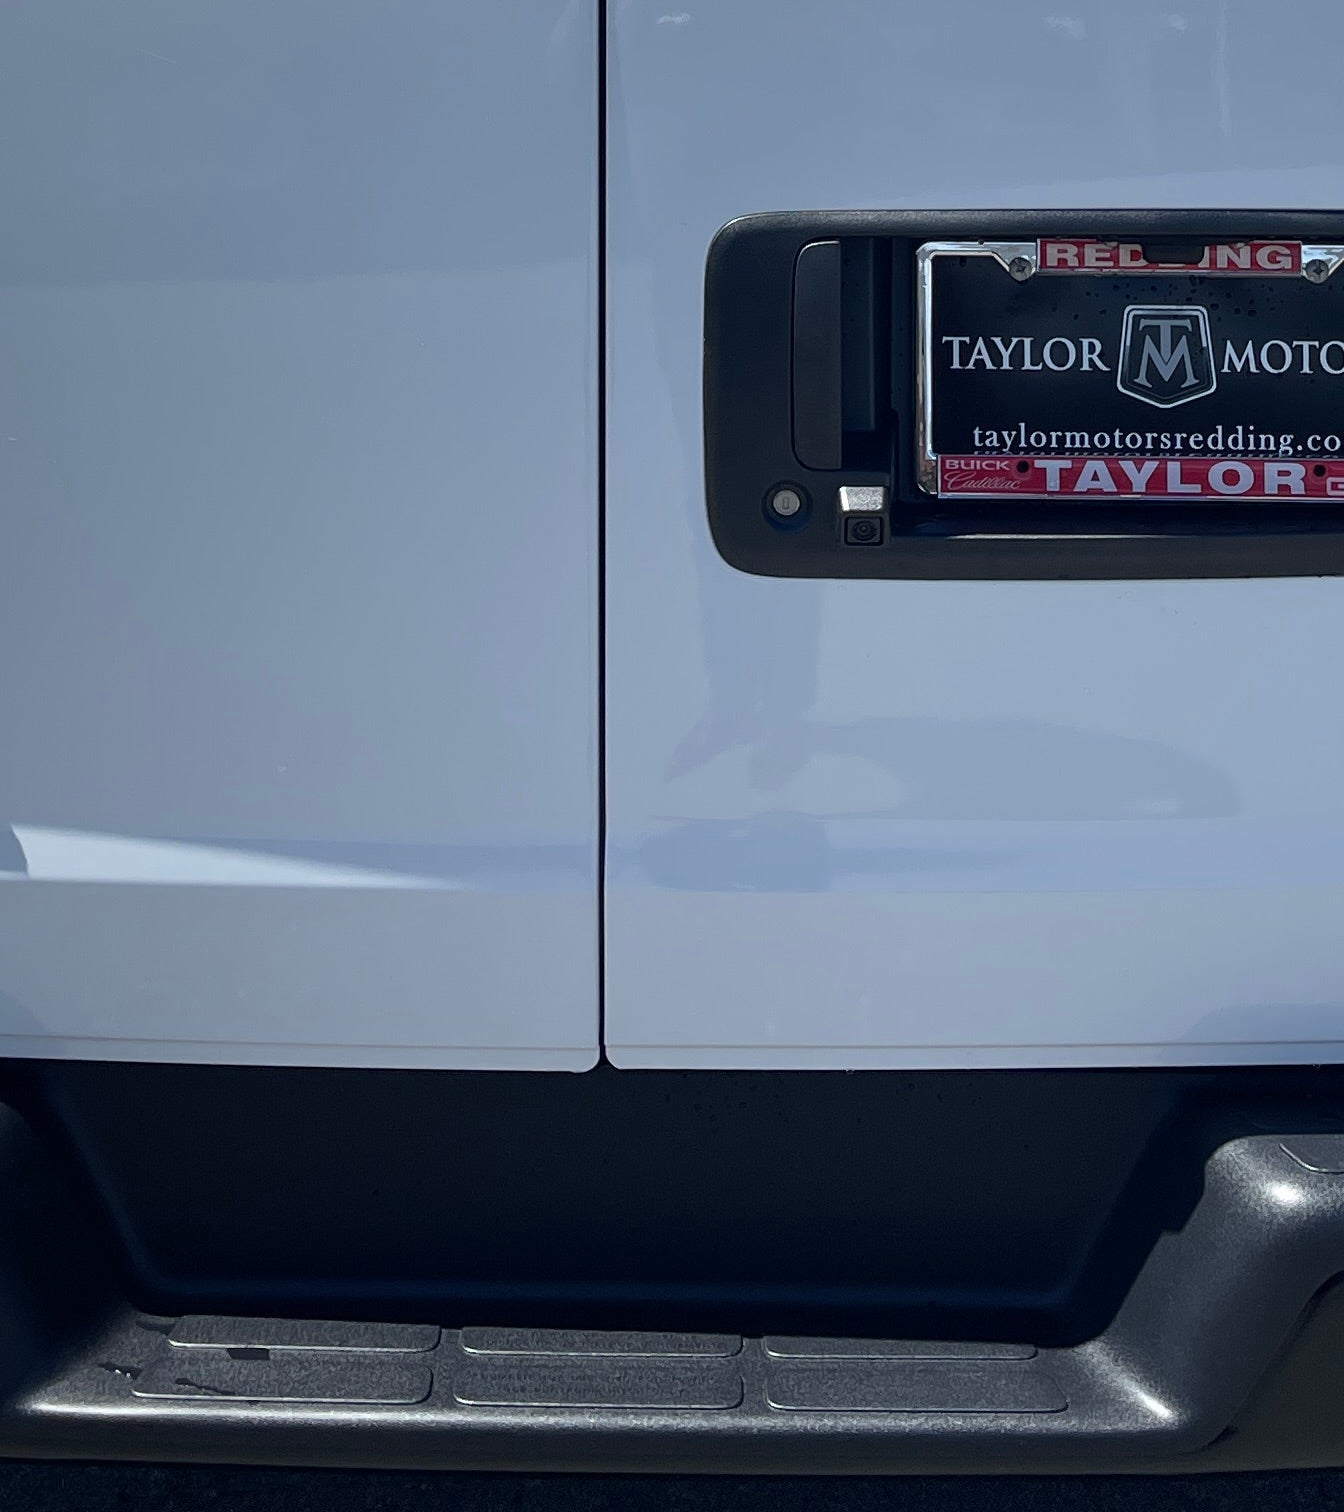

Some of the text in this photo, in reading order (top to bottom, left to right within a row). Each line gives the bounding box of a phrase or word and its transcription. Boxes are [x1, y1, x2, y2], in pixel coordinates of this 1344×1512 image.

[1046, 242, 1293, 269] REDING
[942, 336, 1111, 371] TAYLOR
[944, 459, 1010, 471] BUICK
[1034, 459, 1306, 496] TAYLOR
[944, 470, 1022, 491] Cadillac
